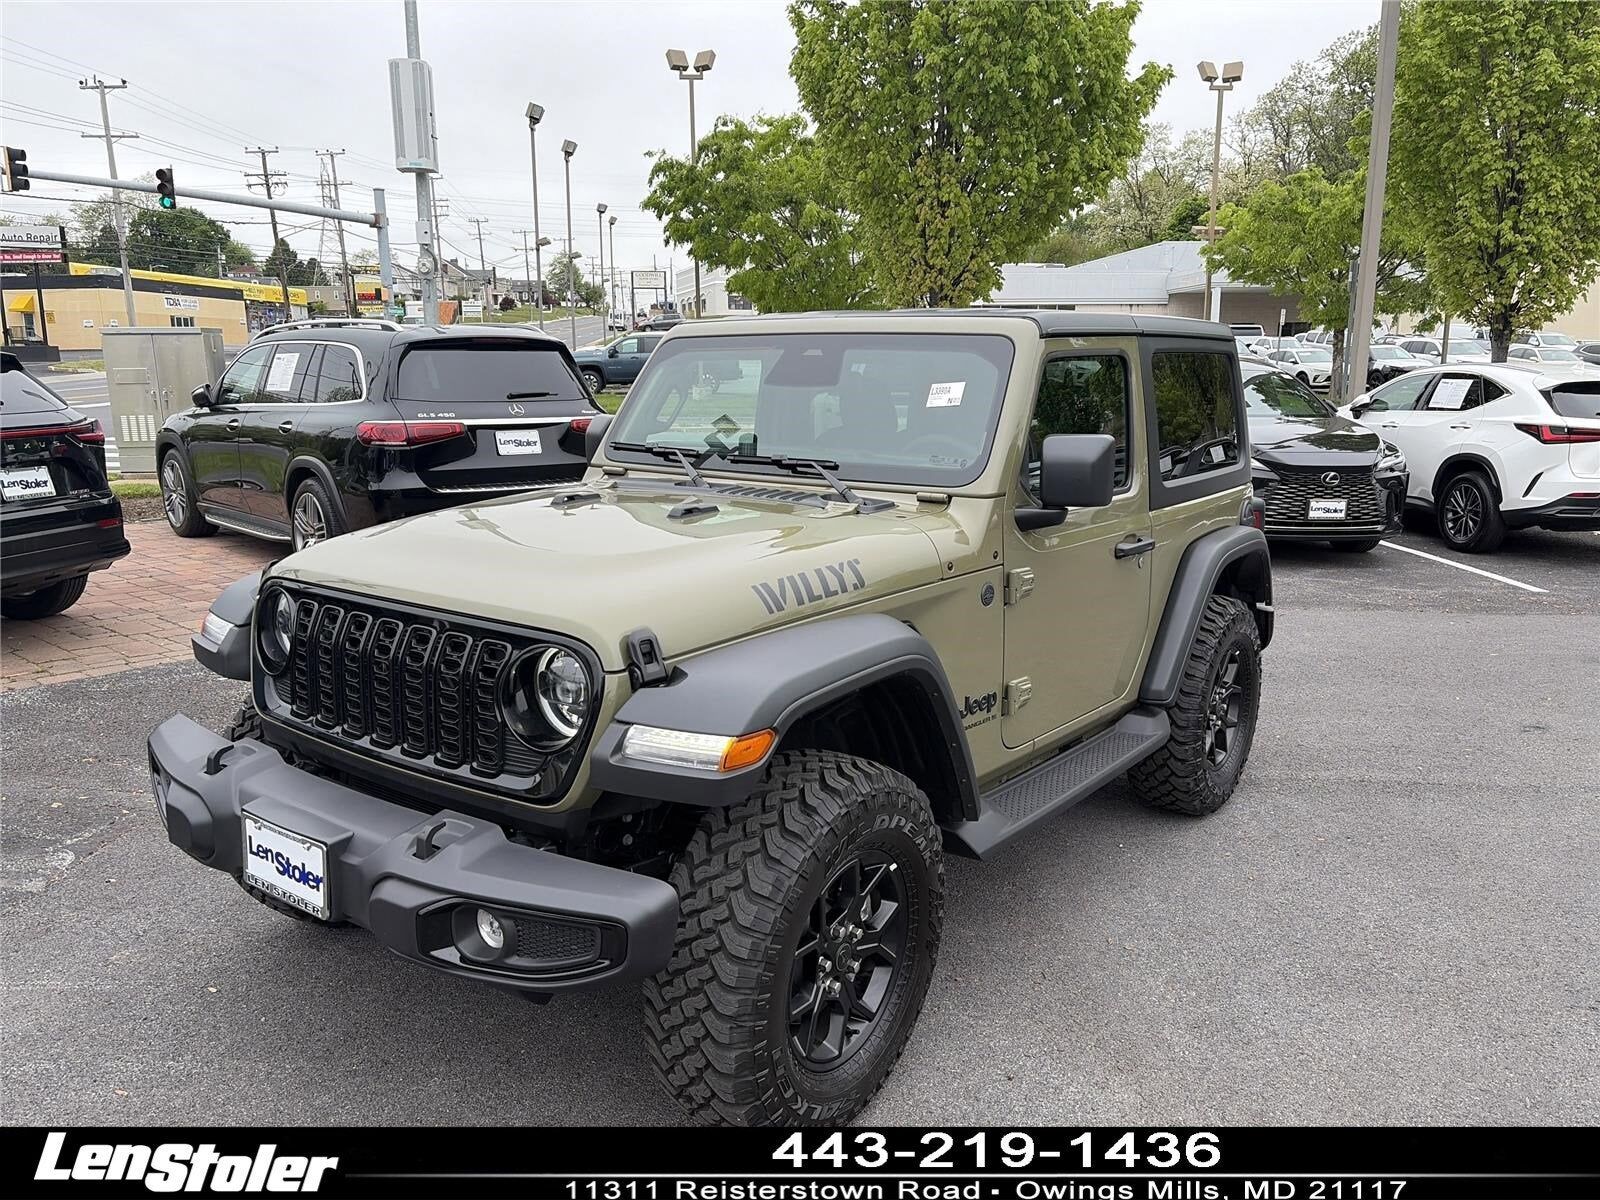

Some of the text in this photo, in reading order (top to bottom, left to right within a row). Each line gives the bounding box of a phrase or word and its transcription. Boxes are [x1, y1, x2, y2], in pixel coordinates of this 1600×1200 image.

[1, 232, 58, 244] Auto Repair
[499, 438, 538, 448] LenStoler
[2, 478, 48, 490] LenStoler
[1311, 505, 1345, 514] LenStoler
[752, 558, 866, 615] WILLYS
[959, 691, 997, 720] Jeep
[248, 835, 323, 892] LenStoler
[247, 874, 320, 916] LEN STOLER
